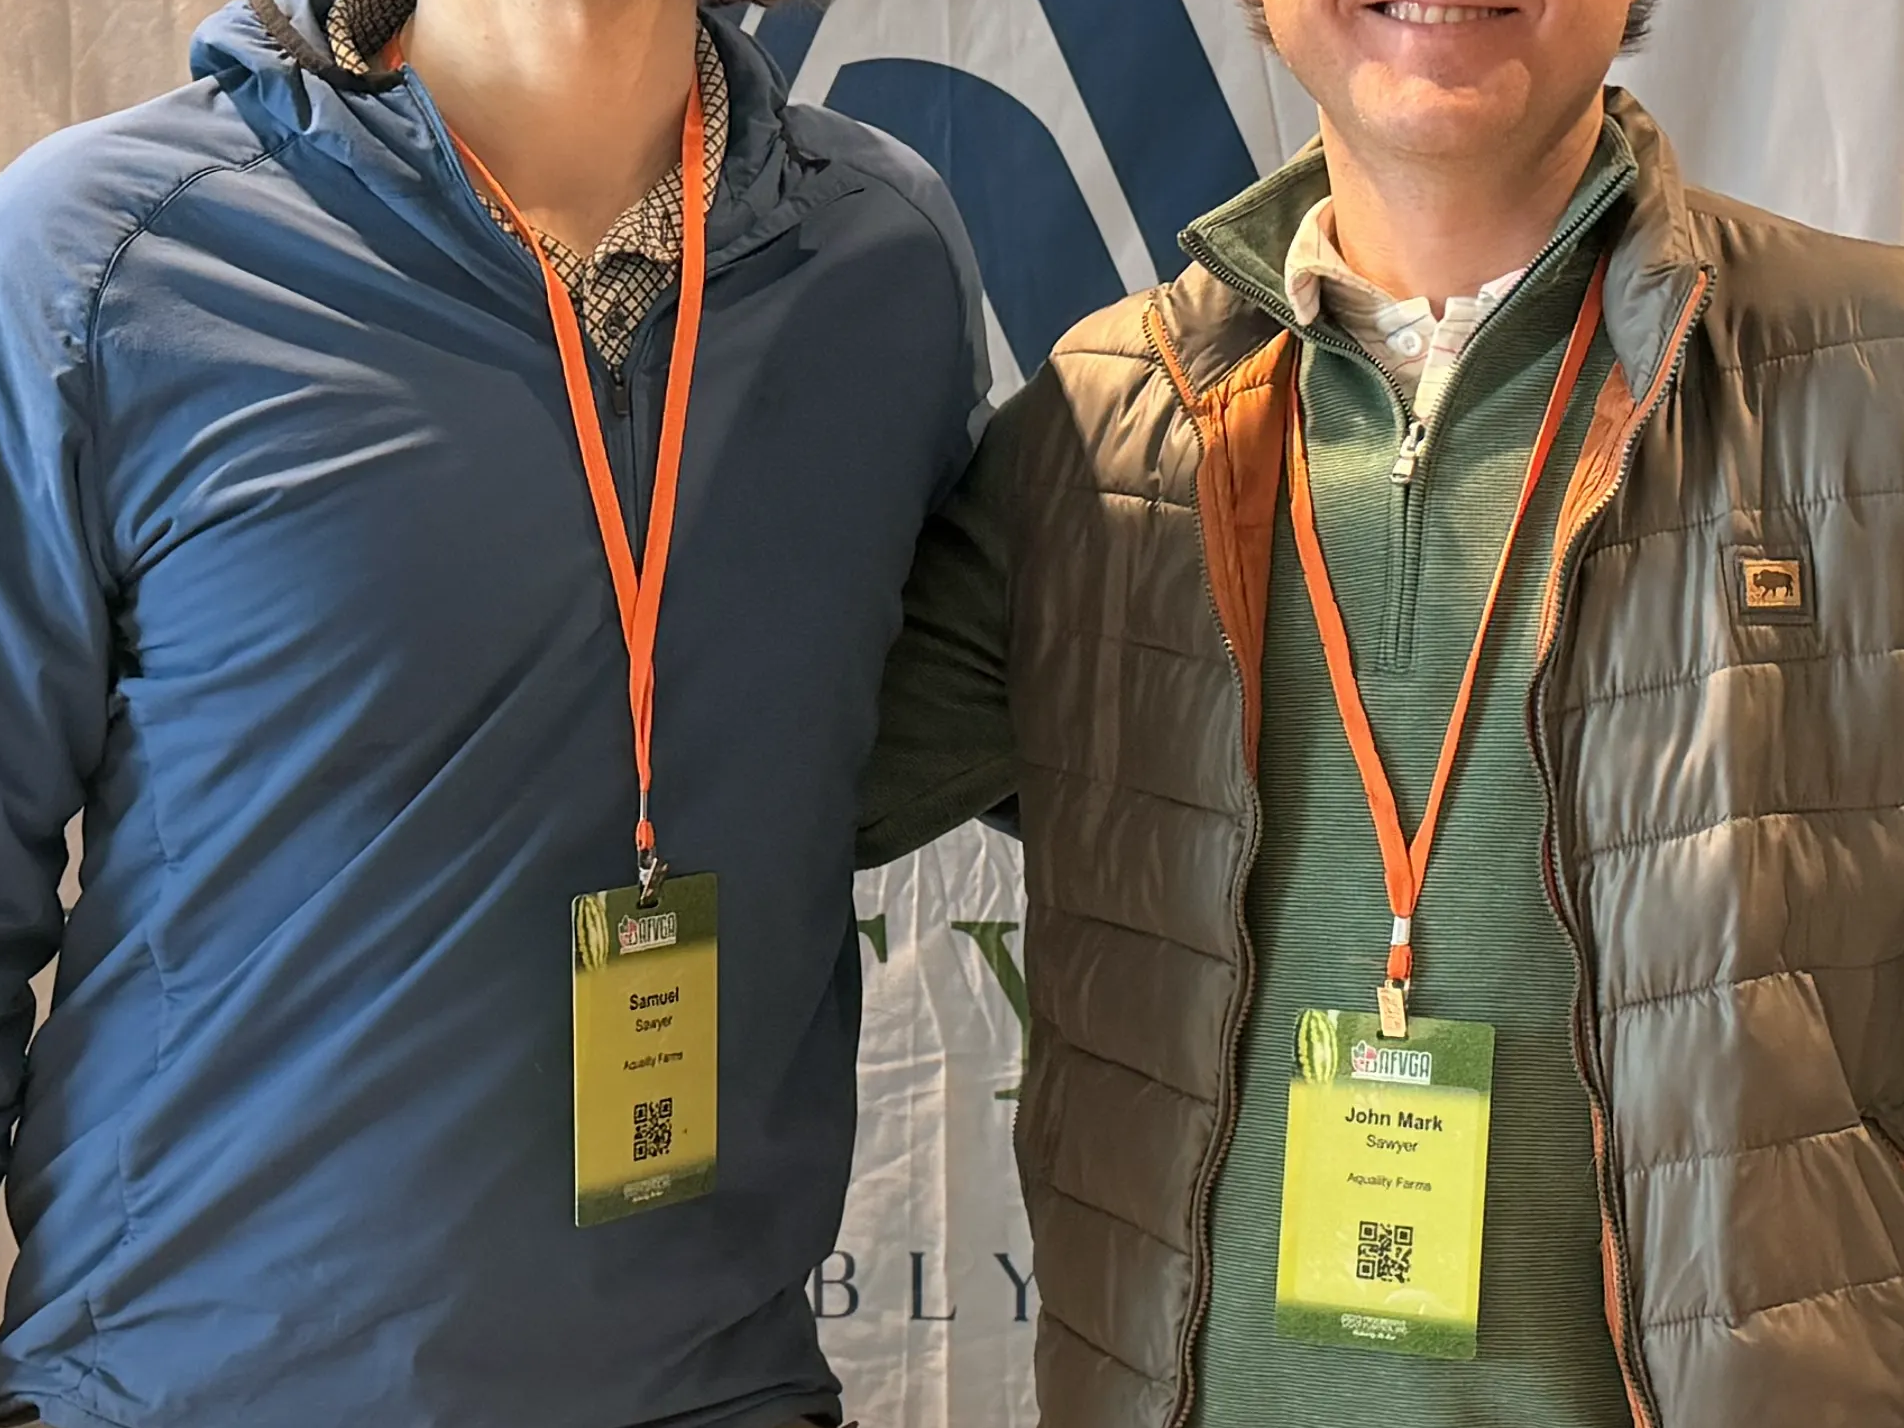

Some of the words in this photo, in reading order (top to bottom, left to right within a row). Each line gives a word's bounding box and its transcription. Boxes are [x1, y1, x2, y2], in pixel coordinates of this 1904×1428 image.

[630, 987, 680, 1011] Samuel
[1378, 1049, 1432, 1080] AFVGA
[1345, 1107, 1391, 1128] John
[1398, 1111, 1443, 1132] Mark
[1366, 1134, 1419, 1154] Sawyer
